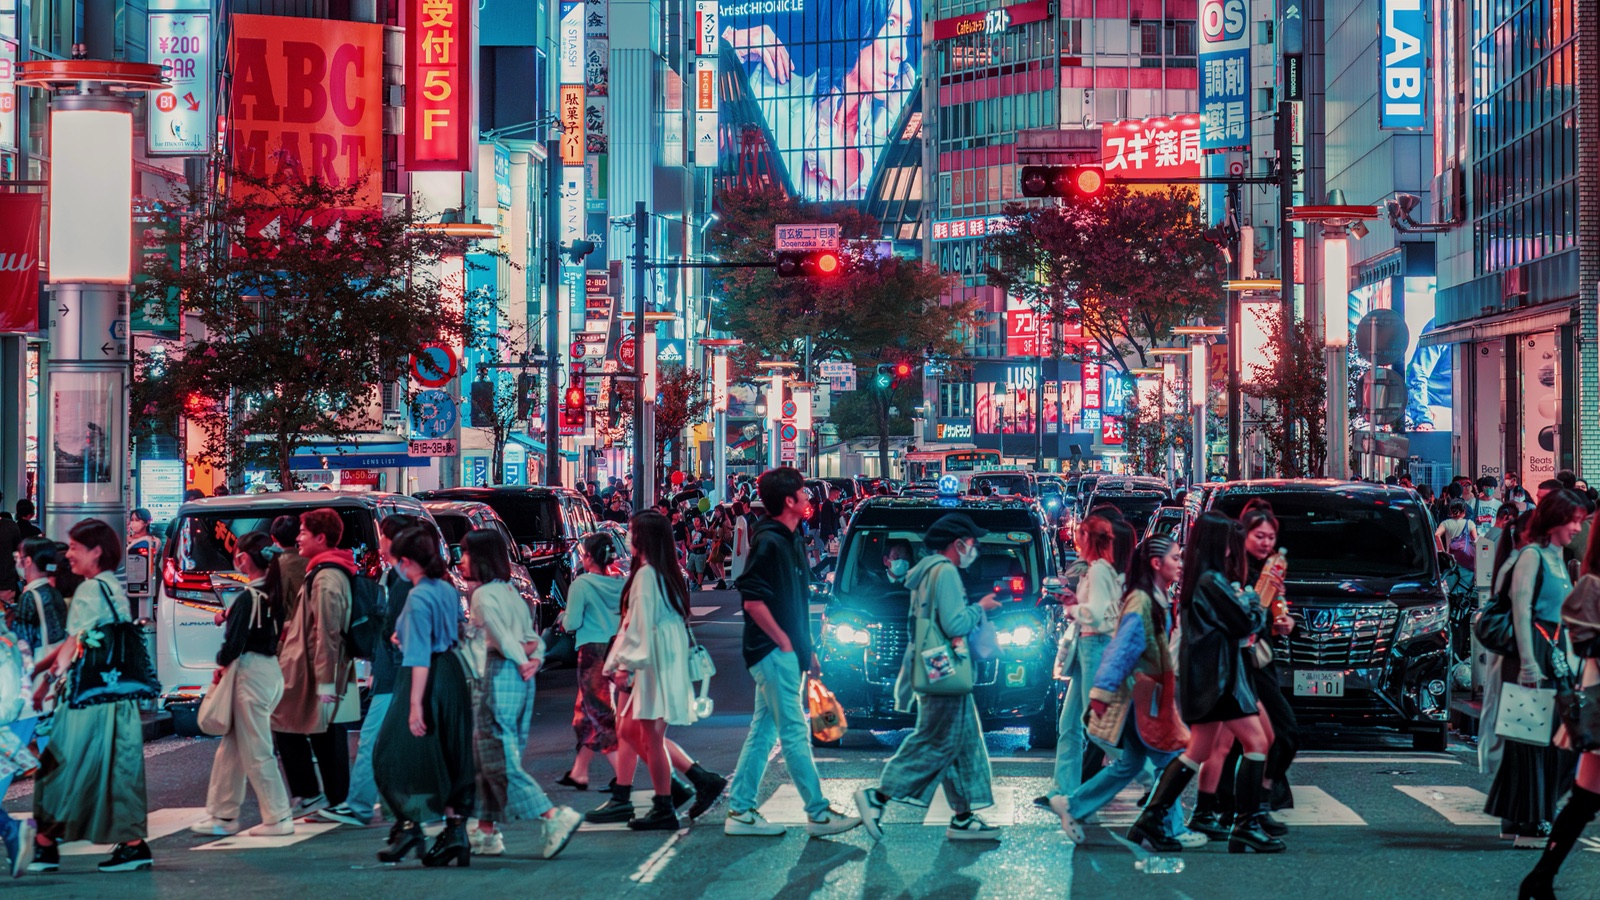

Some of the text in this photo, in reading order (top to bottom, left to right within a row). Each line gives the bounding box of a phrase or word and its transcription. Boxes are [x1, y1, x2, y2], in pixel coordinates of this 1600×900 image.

[985, 9, 1009, 34] ガスト
[1204, 1, 1243, 37] OS
[159, 36, 199, 54] ¥200
[705, 13, 715, 53] スシロー
[568, 29, 578, 68] STLASSH
[1386, 0, 1420, 116] LABI
[162, 58, 195, 78] BAR
[1205, 57, 1244, 98] 調剤
[232, 37, 365, 127] ABC
[160, 97, 173, 108] B1
[565, 93, 579, 157] 駄菓子バー
[1205, 101, 1244, 142] 薬局
[229, 129, 366, 187] MART
[1106, 128, 1200, 171] スギ薬局
[779, 227, 836, 240] 道玄坂二丁目東
[942, 246, 972, 271] AGA
[1024, 339, 1032, 352] 3F
[1107, 377, 1122, 407] 24
[433, 419, 446, 432] 40
[1530, 456, 1552, 464] Beats
[1530, 464, 1555, 472] Studio
[945, 481, 953, 489] N
